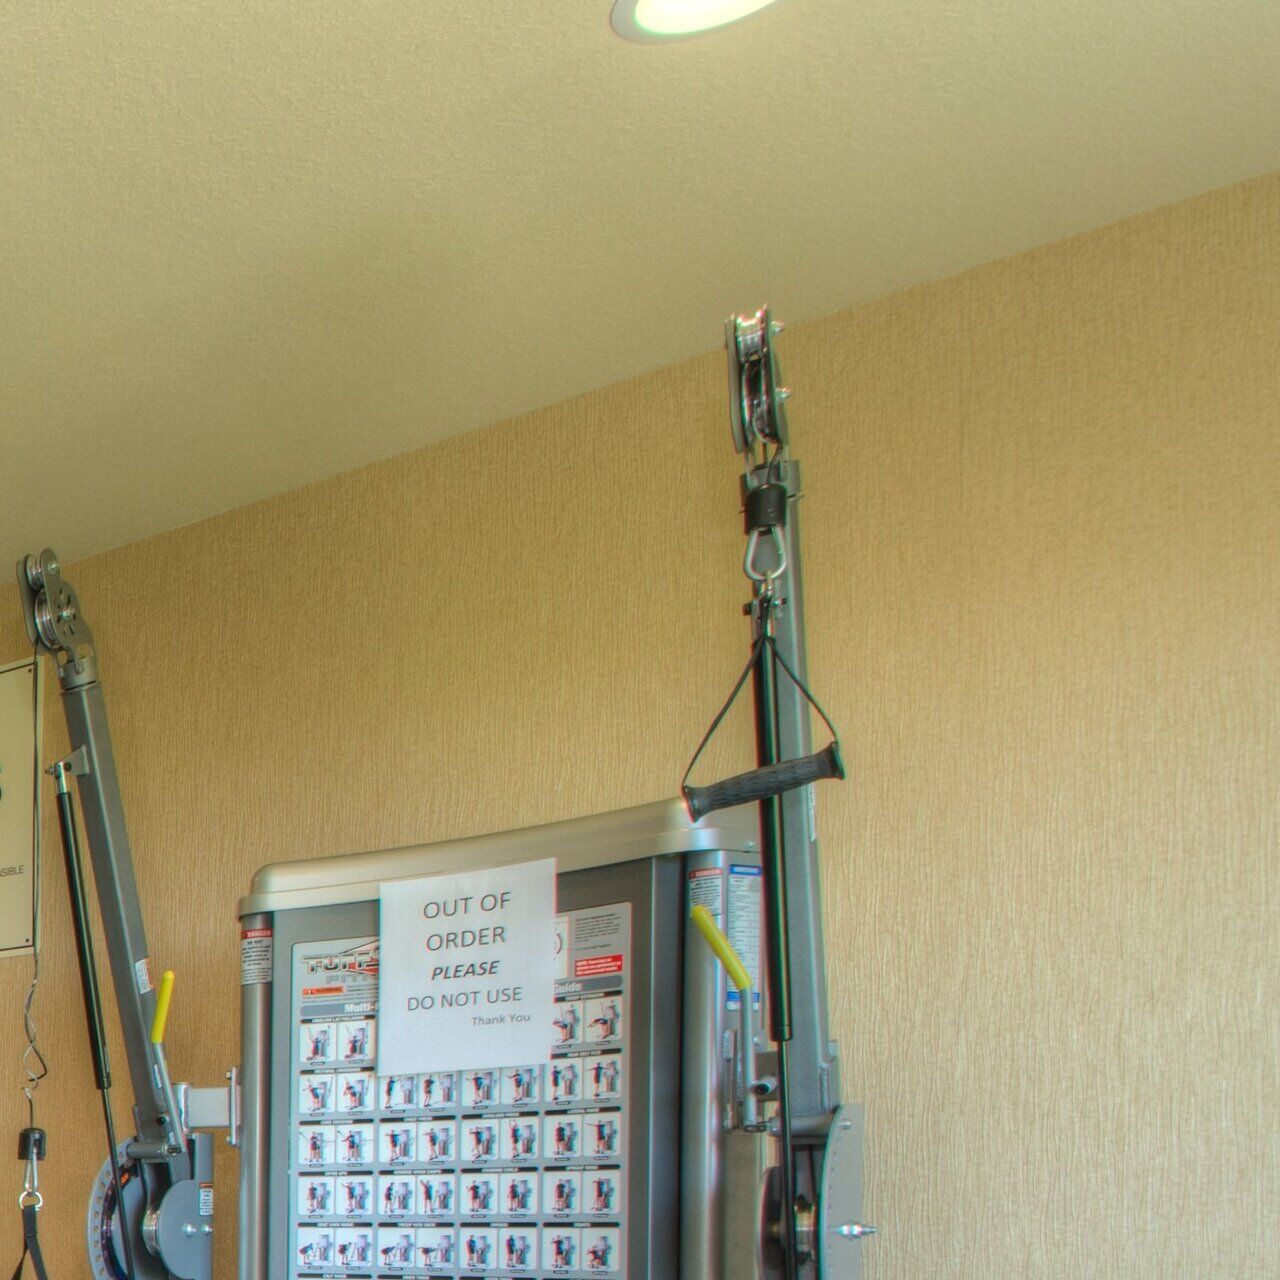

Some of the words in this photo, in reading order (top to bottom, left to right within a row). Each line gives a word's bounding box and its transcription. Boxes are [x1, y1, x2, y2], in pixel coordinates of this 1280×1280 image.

[423, 897, 473, 919] OUT
[480, 891, 511, 912] OF
[426, 926, 505, 951] ORDER
[431, 960, 500, 981] PLEASE
[407, 995, 434, 1012] DO
[440, 991, 480, 1008] NOT
[486, 986, 523, 1004] USE
[470, 1016, 505, 1026] Thank
[508, 1013, 531, 1022] You
